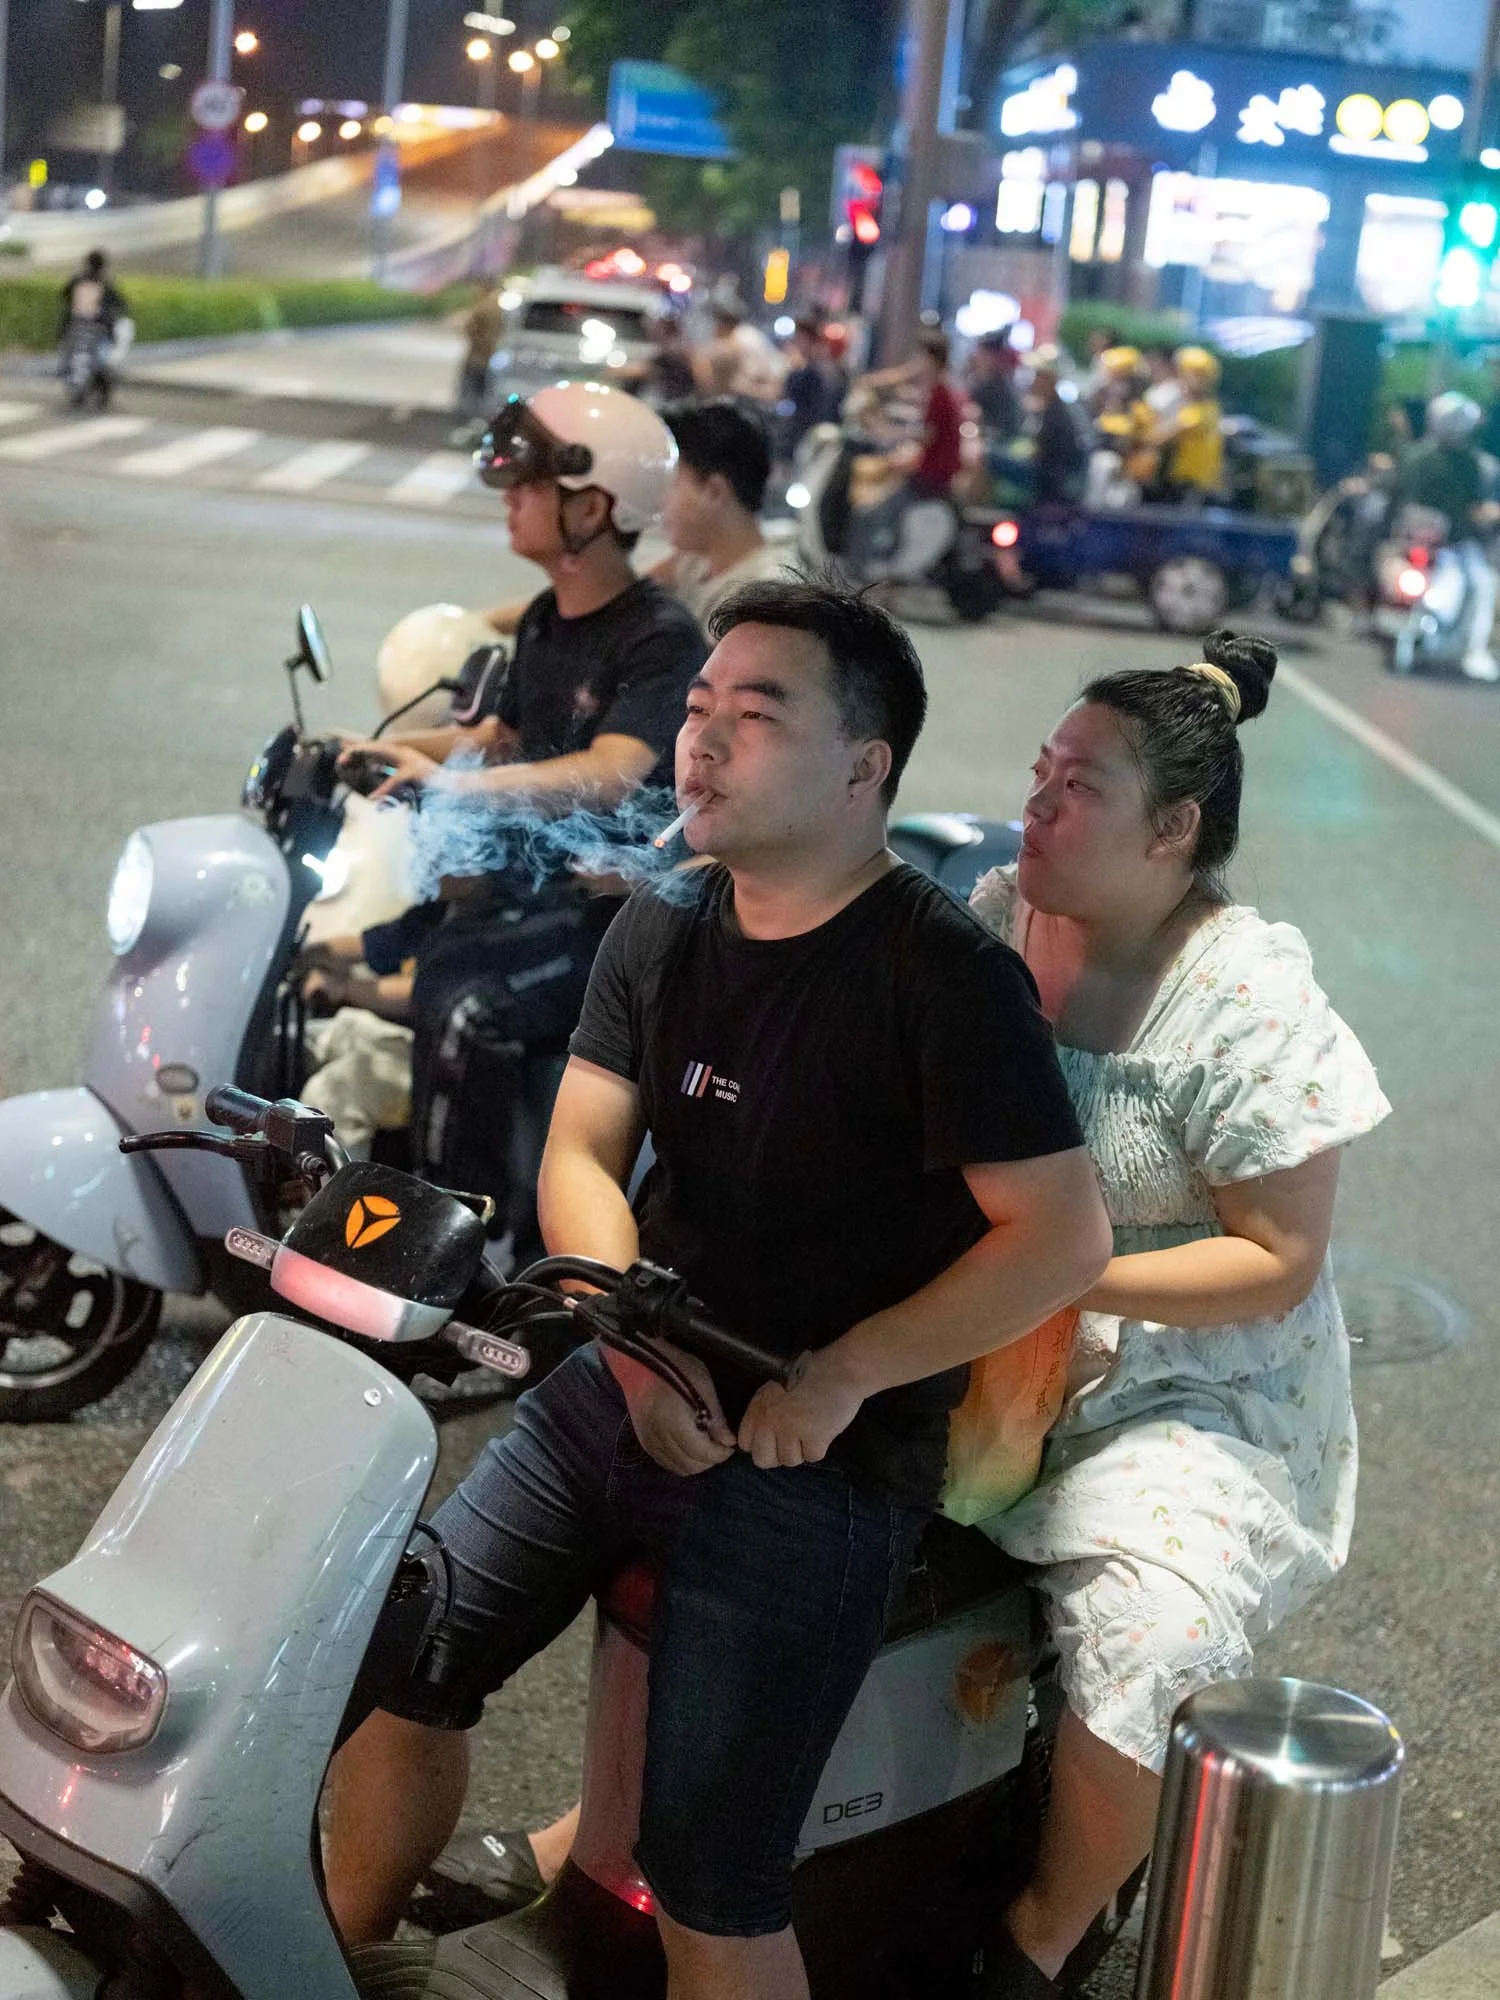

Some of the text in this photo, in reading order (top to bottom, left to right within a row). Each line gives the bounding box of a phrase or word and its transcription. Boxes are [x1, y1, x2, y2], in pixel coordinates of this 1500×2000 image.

[712, 1075, 727, 1087] THE
[715, 1089, 737, 1102] MUSIC
[823, 1791, 883, 1824] DE3
